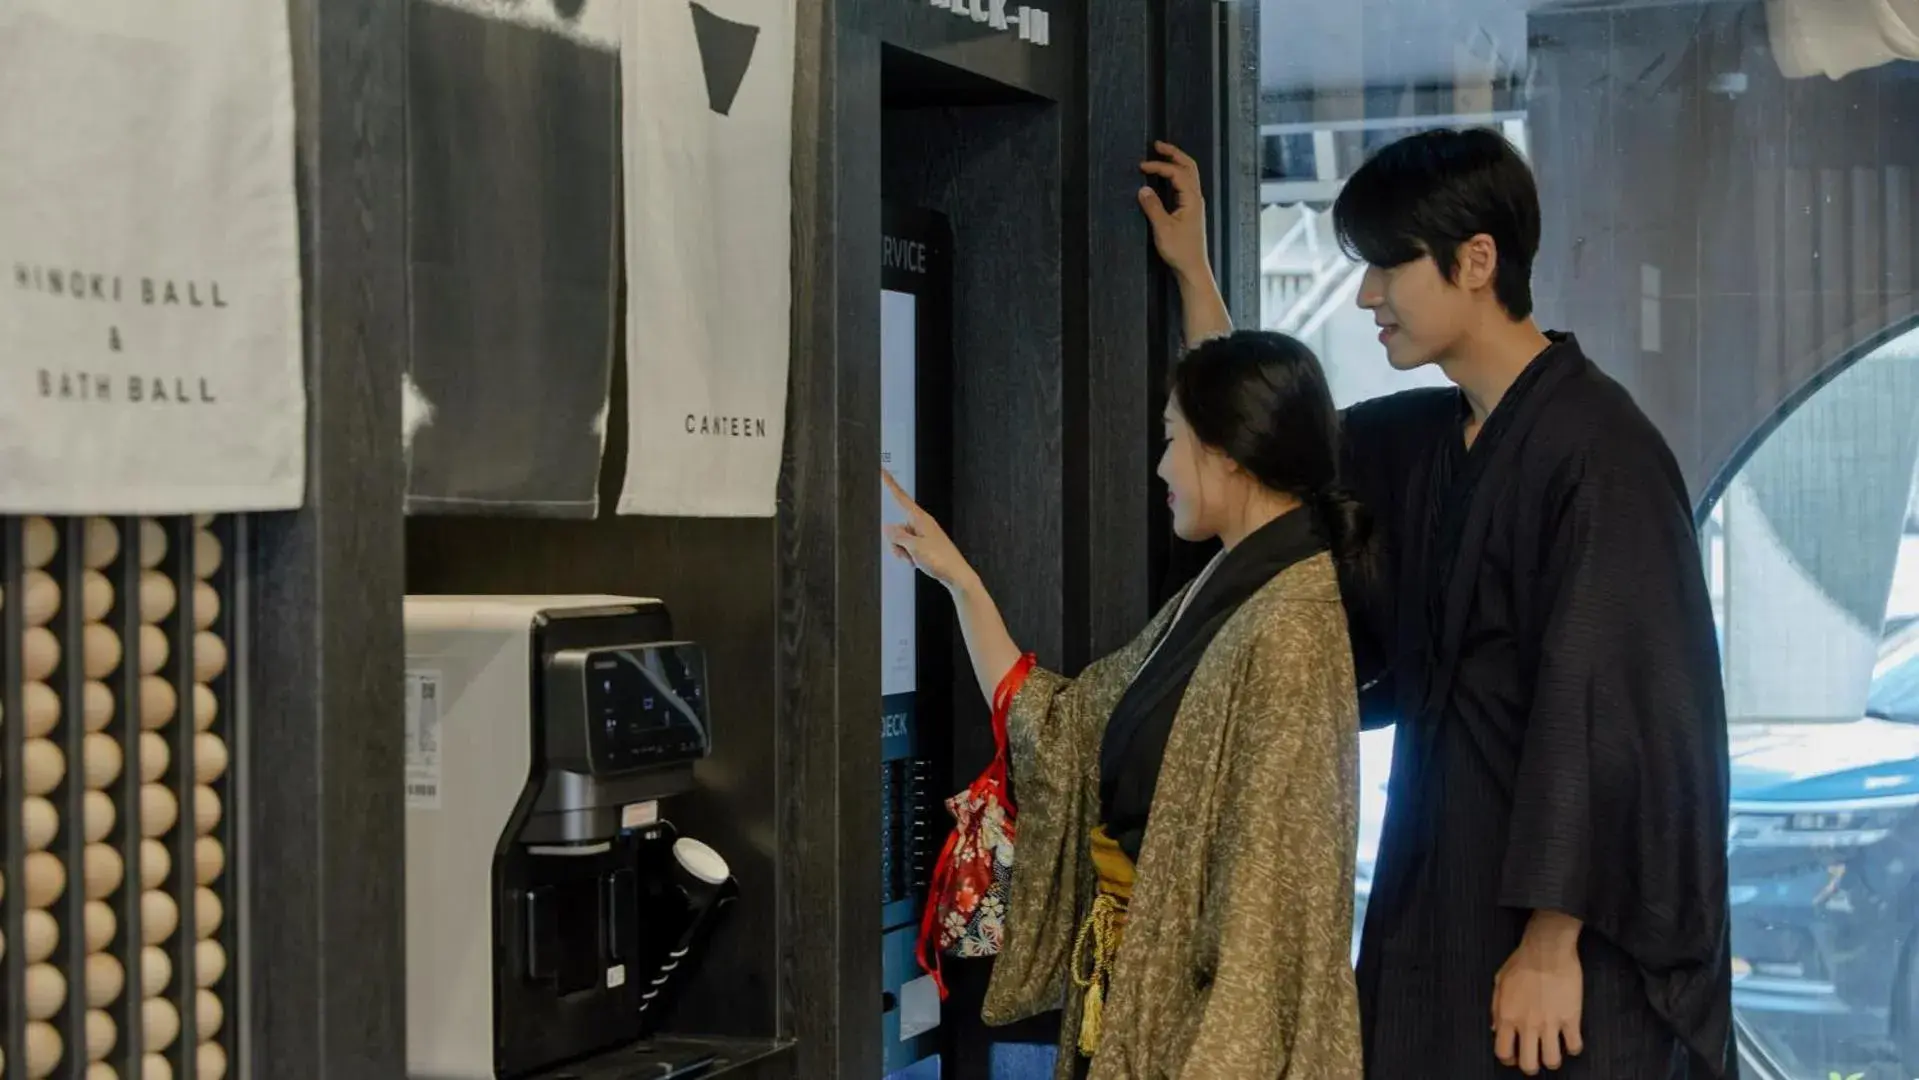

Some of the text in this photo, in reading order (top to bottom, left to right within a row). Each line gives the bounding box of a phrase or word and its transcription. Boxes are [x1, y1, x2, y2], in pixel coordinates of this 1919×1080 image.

[14, 262, 228, 308] HINOKI BALL
[37, 367, 217, 404] BATH BALL
[685, 414, 766, 437] CANTEEN
